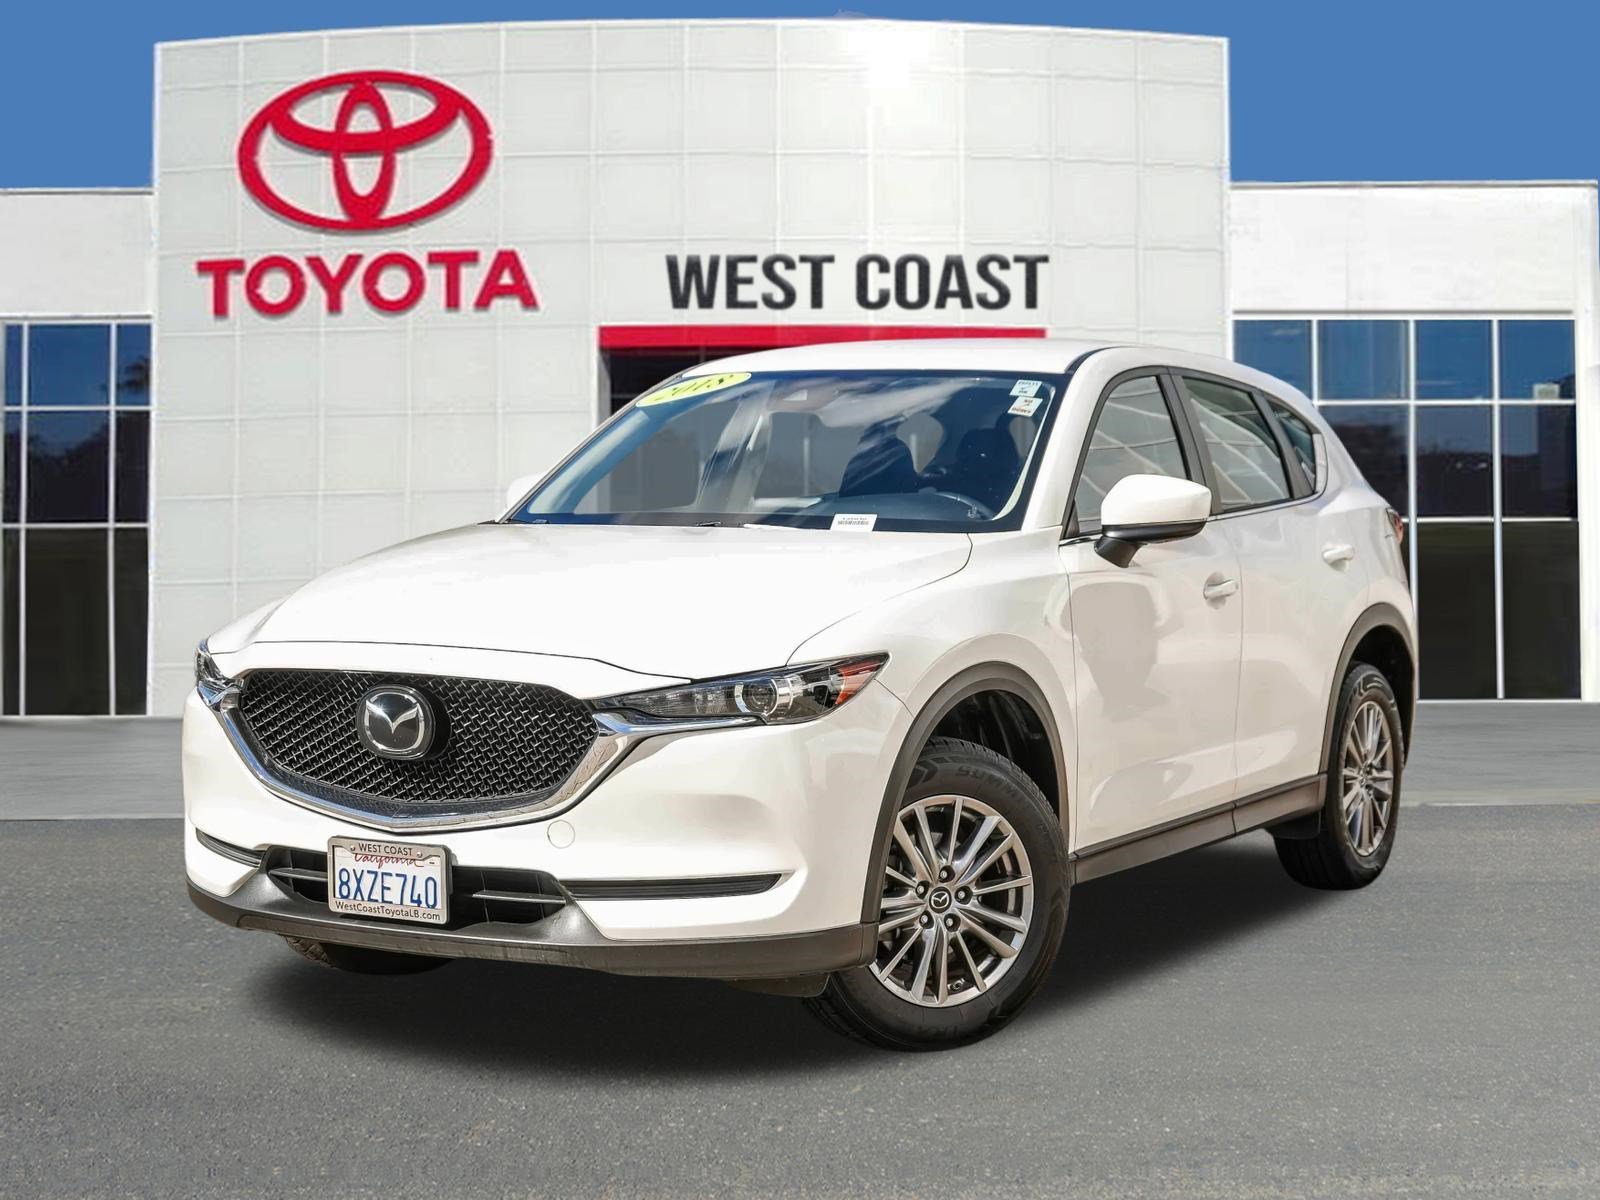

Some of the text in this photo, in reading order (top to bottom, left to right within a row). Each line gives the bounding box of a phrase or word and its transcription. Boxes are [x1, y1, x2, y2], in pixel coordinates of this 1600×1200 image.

[196, 249, 539, 318] TOYOTA
[665, 253, 1050, 310] WEST COAST
[358, 842, 413, 856] WEST COAST
[339, 867, 438, 909] 8XZE740
[335, 900, 441, 921] WestCoastToyotaLB.com
